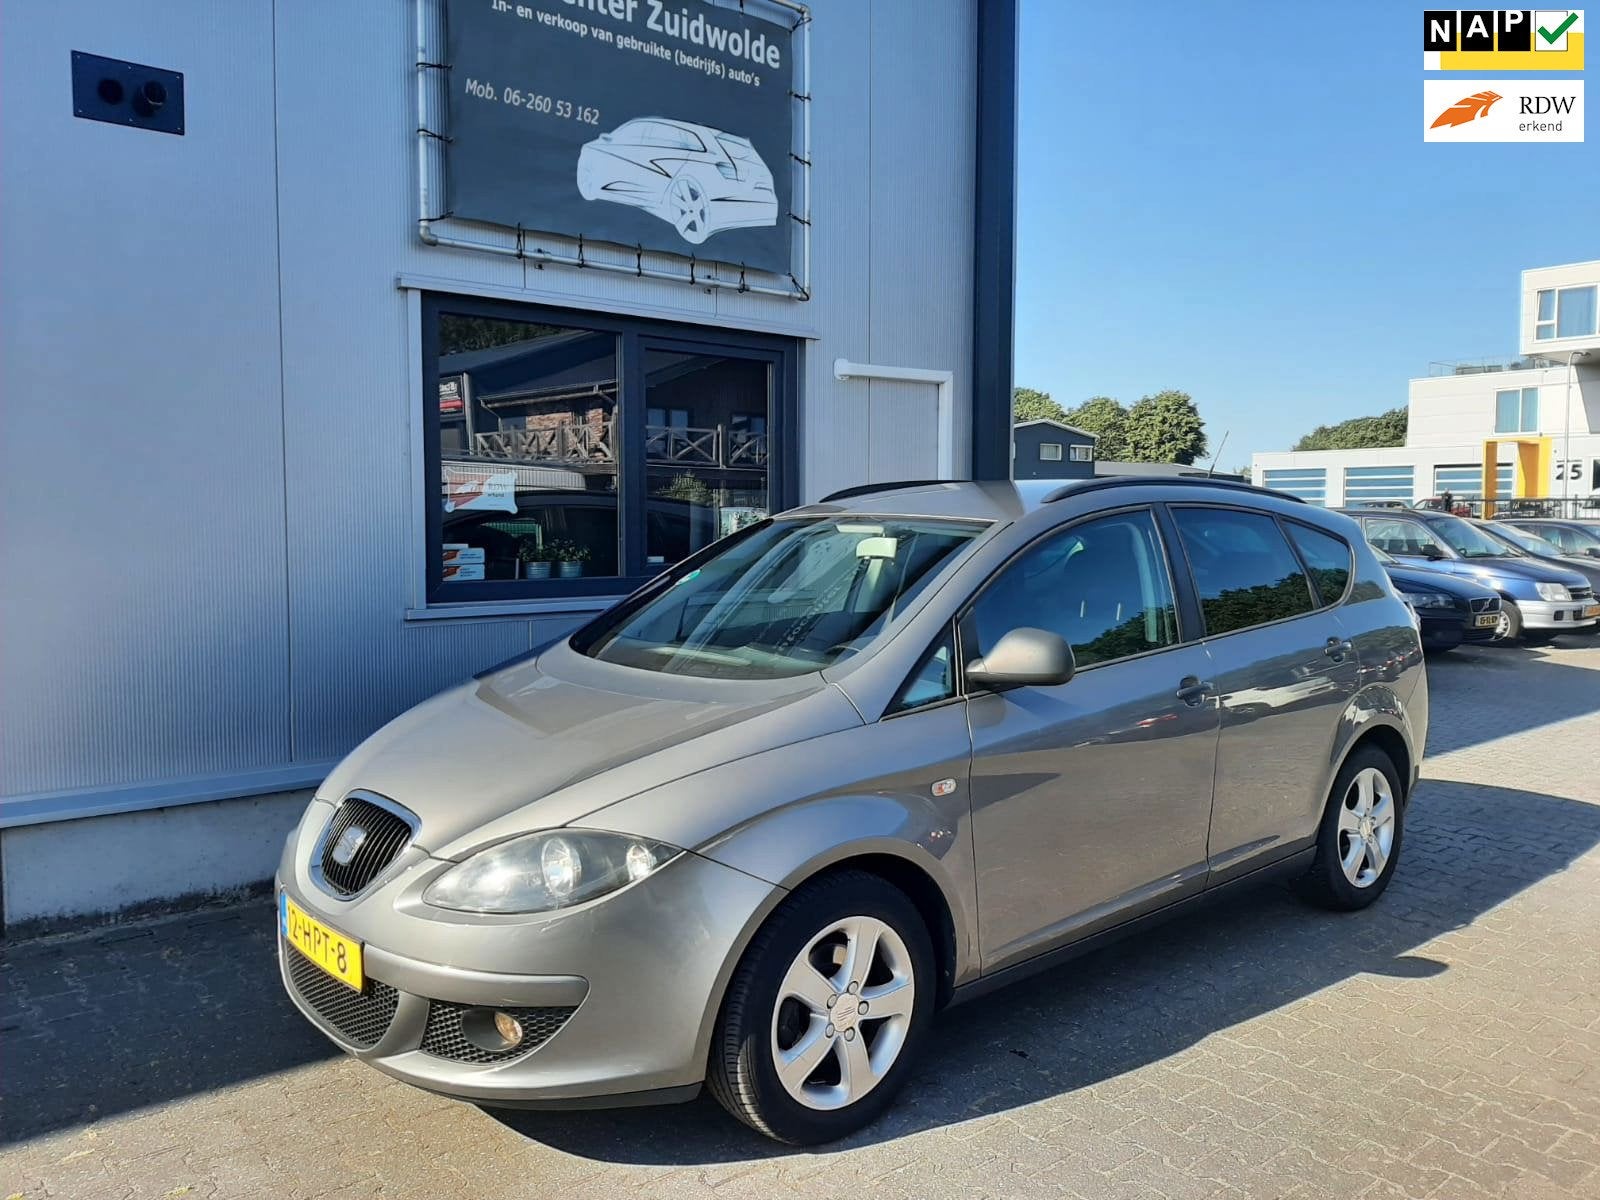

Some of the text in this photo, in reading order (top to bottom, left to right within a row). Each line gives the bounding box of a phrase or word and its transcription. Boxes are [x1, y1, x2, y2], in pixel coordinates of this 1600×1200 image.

[516, 5, 533, 19] en
[537, 10, 587, 37] verkoop
[591, 27, 613, 43] van
[616, 35, 671, 60] gebruikte
[674, 49, 725, 79] (bedrijfs)
[728, 67, 760, 87] auto's
[646, 0, 780, 69] Zuidwolde
[465, 78, 599, 125] Mob. 06-260 53 162
[1555, 463, 1582, 480] 25
